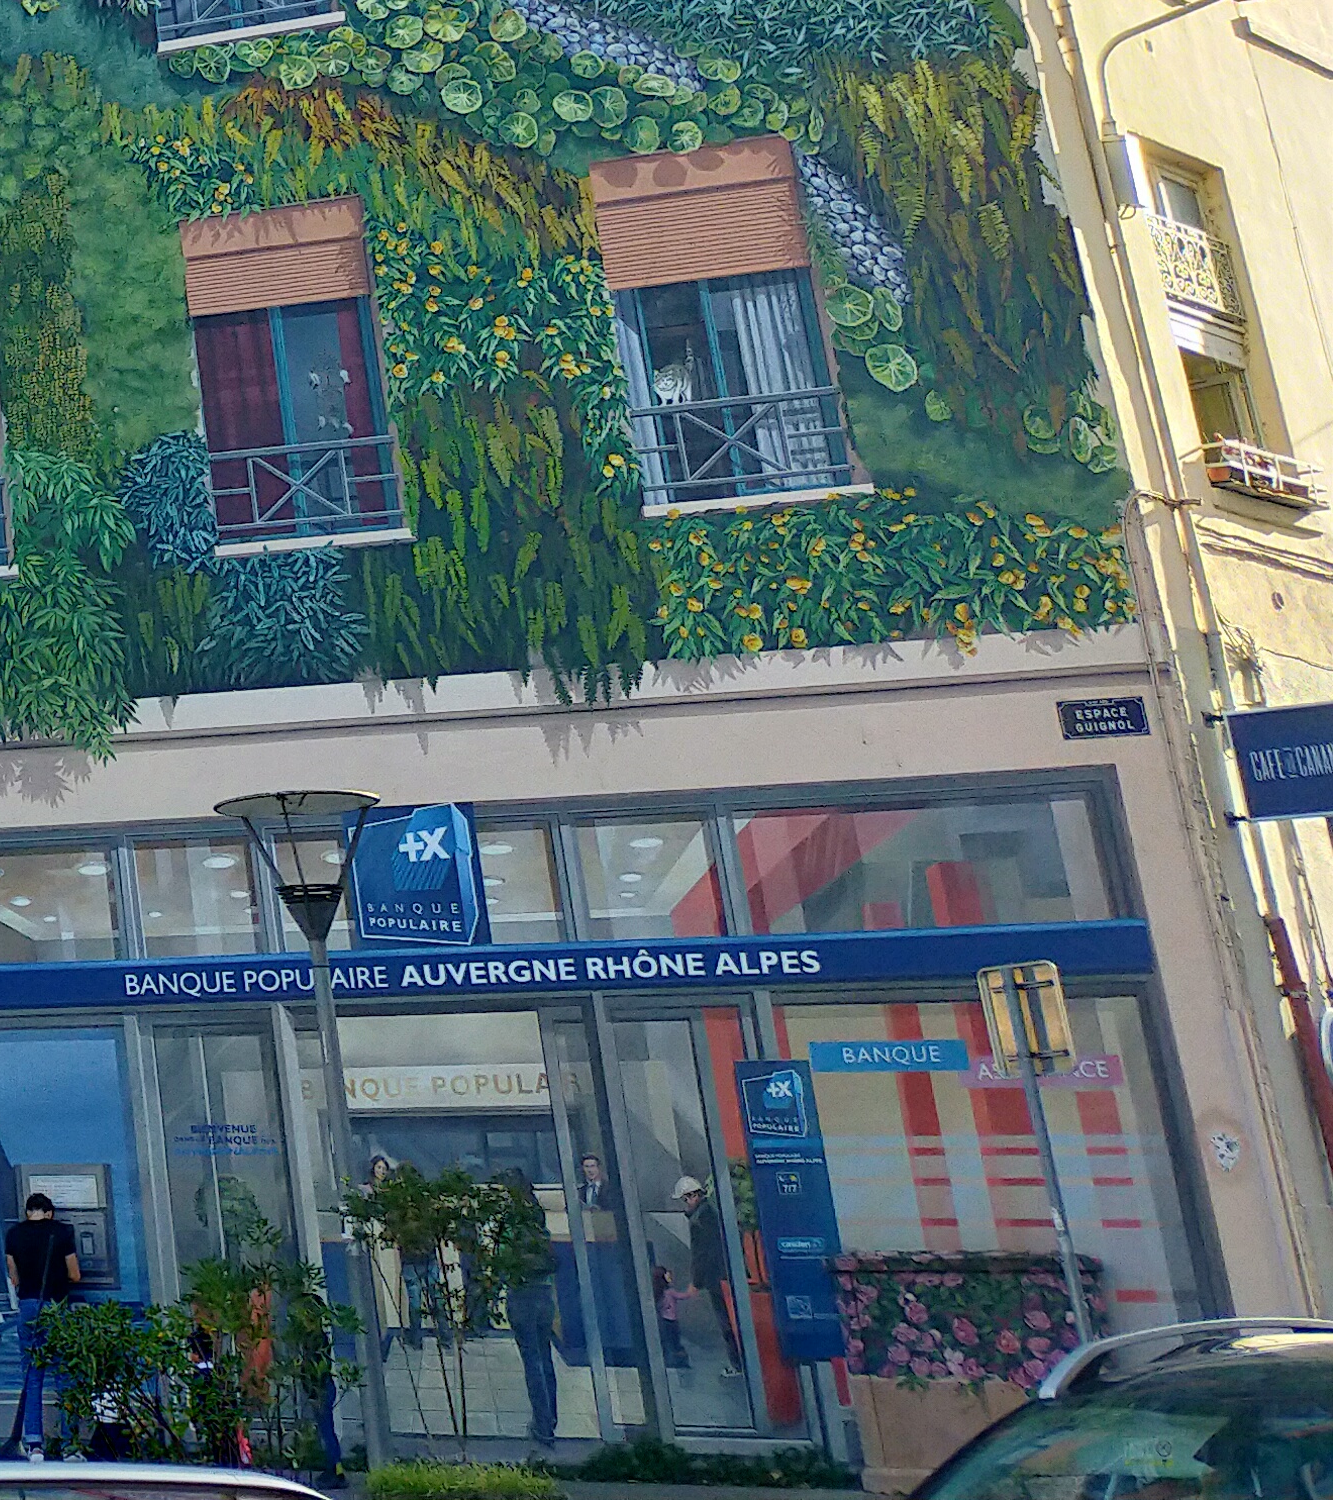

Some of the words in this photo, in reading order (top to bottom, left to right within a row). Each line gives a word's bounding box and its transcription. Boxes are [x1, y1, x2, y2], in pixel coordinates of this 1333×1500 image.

[1075, 706, 1128, 720] ESPACE
[1075, 719, 1135, 733] GUIGNOL
[366, 902, 461, 916] BANQUE
[368, 917, 463, 933] POPULAIRE
[124, 970, 237, 998] BANQUE
[243, 965, 390, 993] POPUAIRE
[399, 958, 578, 988] AUVERGNE
[586, 948, 707, 980] RHÔNE
[715, 949, 822, 977] ALPES
[842, 1044, 941, 1066] BANQUE
